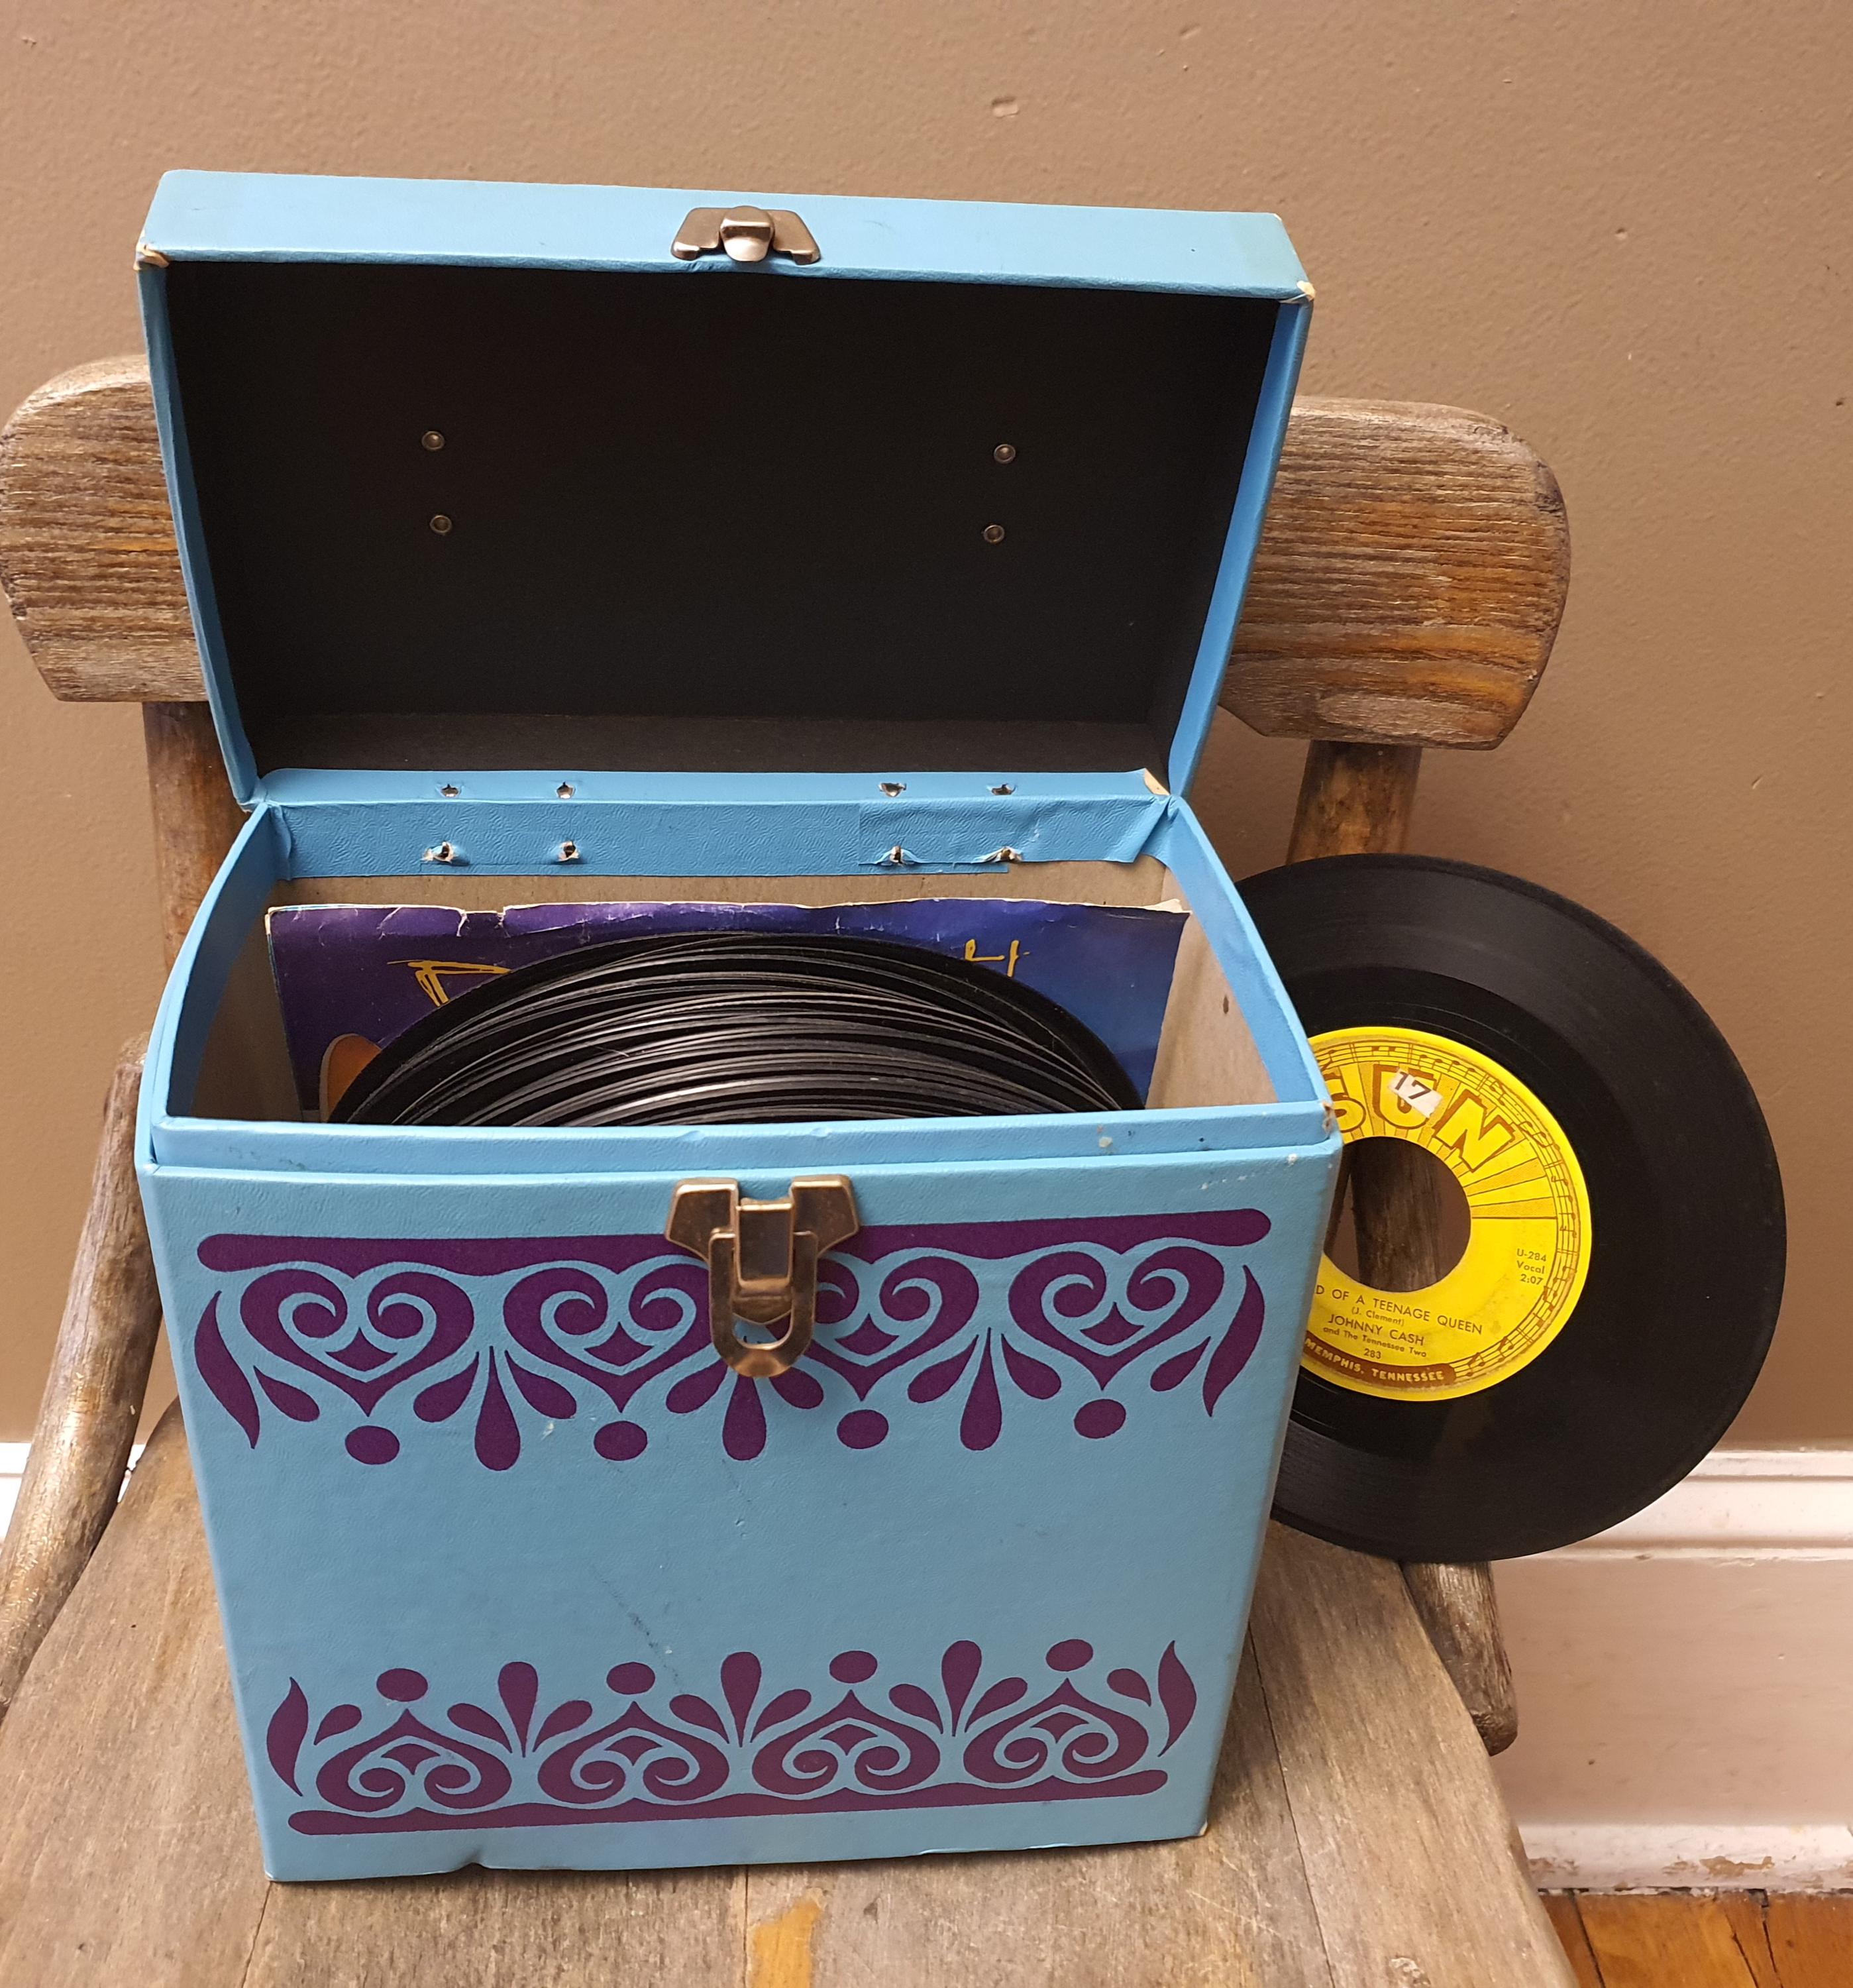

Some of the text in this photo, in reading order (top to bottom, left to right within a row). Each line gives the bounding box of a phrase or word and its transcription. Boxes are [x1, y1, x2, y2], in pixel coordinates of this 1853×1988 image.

[1395, 1071, 1431, 1099] 17
[1516, 1248, 1547, 1262] U-284
[1516, 1260, 1545, 1274] Vocal
[1520, 1274, 1544, 1285] 2:07
[1332, 1289, 1350, 1300] OF
[1355, 1295, 1365, 1305] A
[1373, 1298, 1430, 1321] TEENAGE
[1437, 1315, 1483, 1335] QUEEN
[1351, 1306, 1404, 1326] (J. Clement)
[1328, 1314, 1424, 1346] JOHNNY CASH
[1323, 1327, 1426, 1357] and The Tennessee Two
[1363, 1348, 1381, 1359] 283
[1372, 1368, 1444, 1382] TENNESSEE
